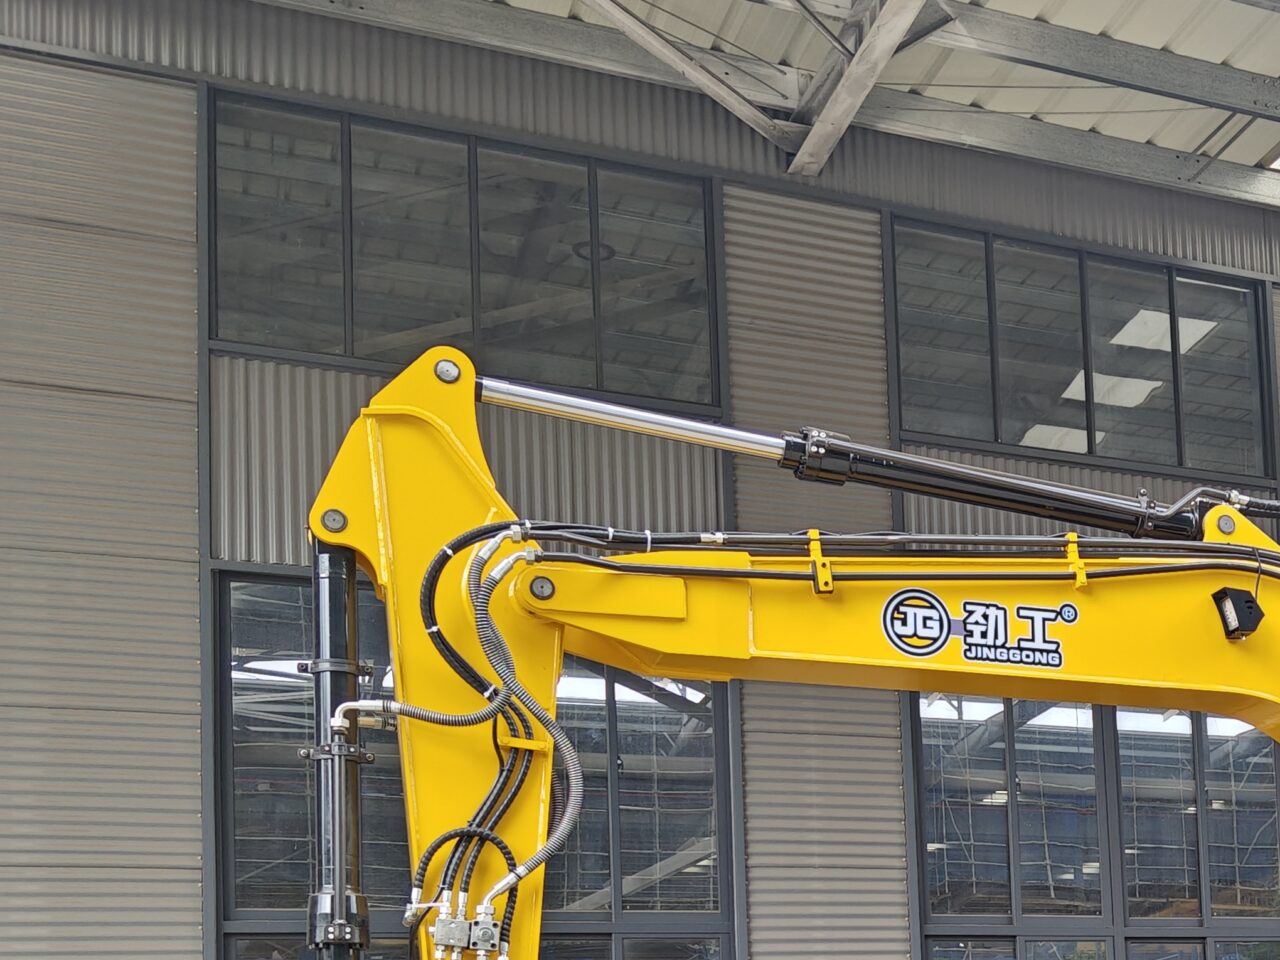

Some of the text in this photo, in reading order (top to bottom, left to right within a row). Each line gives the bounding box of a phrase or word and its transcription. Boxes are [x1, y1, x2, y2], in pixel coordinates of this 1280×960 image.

[893, 604, 940, 639] JG
[964, 602, 1060, 650] 劲工
[964, 647, 1062, 667] JINGGONG
